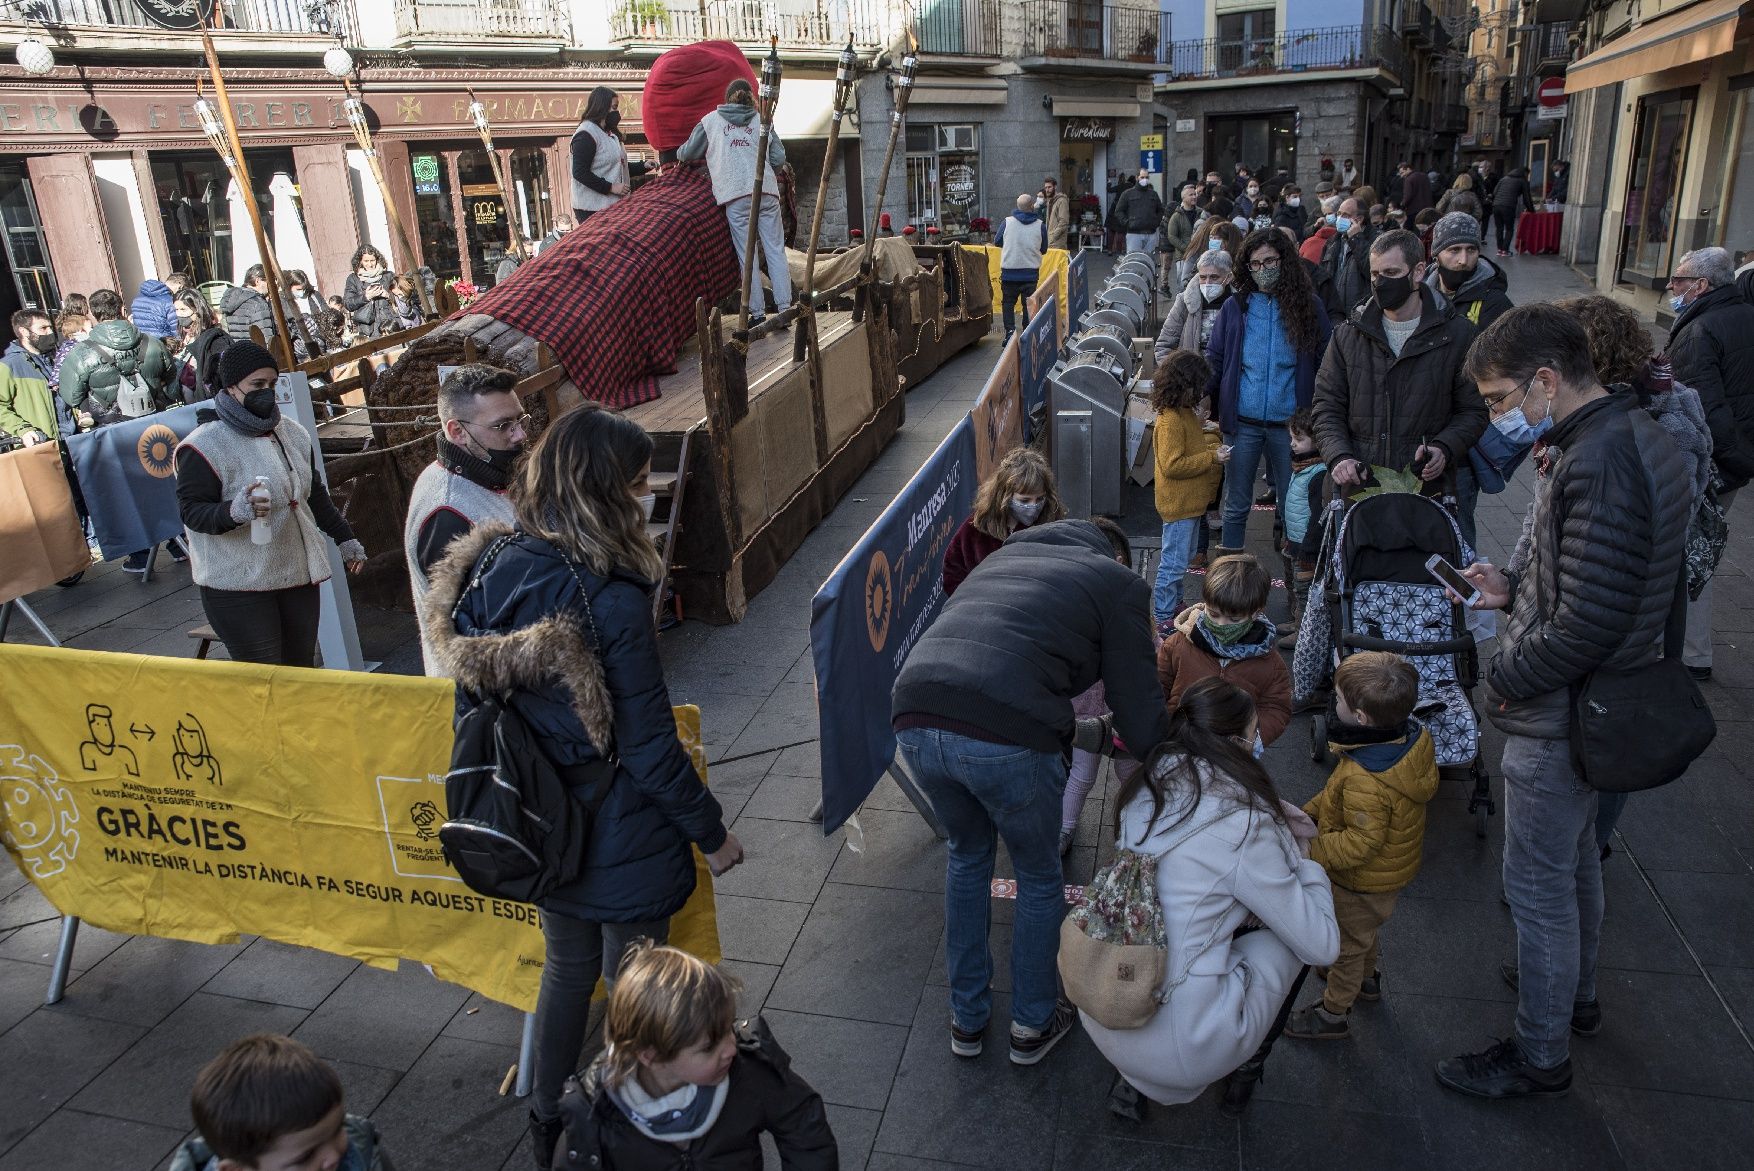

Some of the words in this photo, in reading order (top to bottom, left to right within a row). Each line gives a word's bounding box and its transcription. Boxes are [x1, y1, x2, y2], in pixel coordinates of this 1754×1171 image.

[146, 102, 314, 129] FERER
[946, 182, 974, 192] TORNER
[907, 482, 946, 551] Manresa
[91, 787, 101, 797] LA
[101, 787, 146, 801] DISTÀNCIA
[157, 796, 205, 808] SEGURETAT
[205, 801, 217, 810] DE
[218, 802, 225, 810] 2
[225, 803, 233, 811] M
[122, 782, 162, 795] MANTENIU
[163, 786, 197, 798] SEMPRE
[96, 803, 247, 851] GRÀCIES
[396, 844, 435, 855] RENTAR-SE
[104, 847, 190, 871] MANTENIR
[193, 860, 214, 877] LA
[217, 862, 313, 890] DISTÀNCIA
[316, 876, 341, 893] FA
[343, 879, 404, 904] SEGUR
[410, 890, 486, 913] AQUEST
